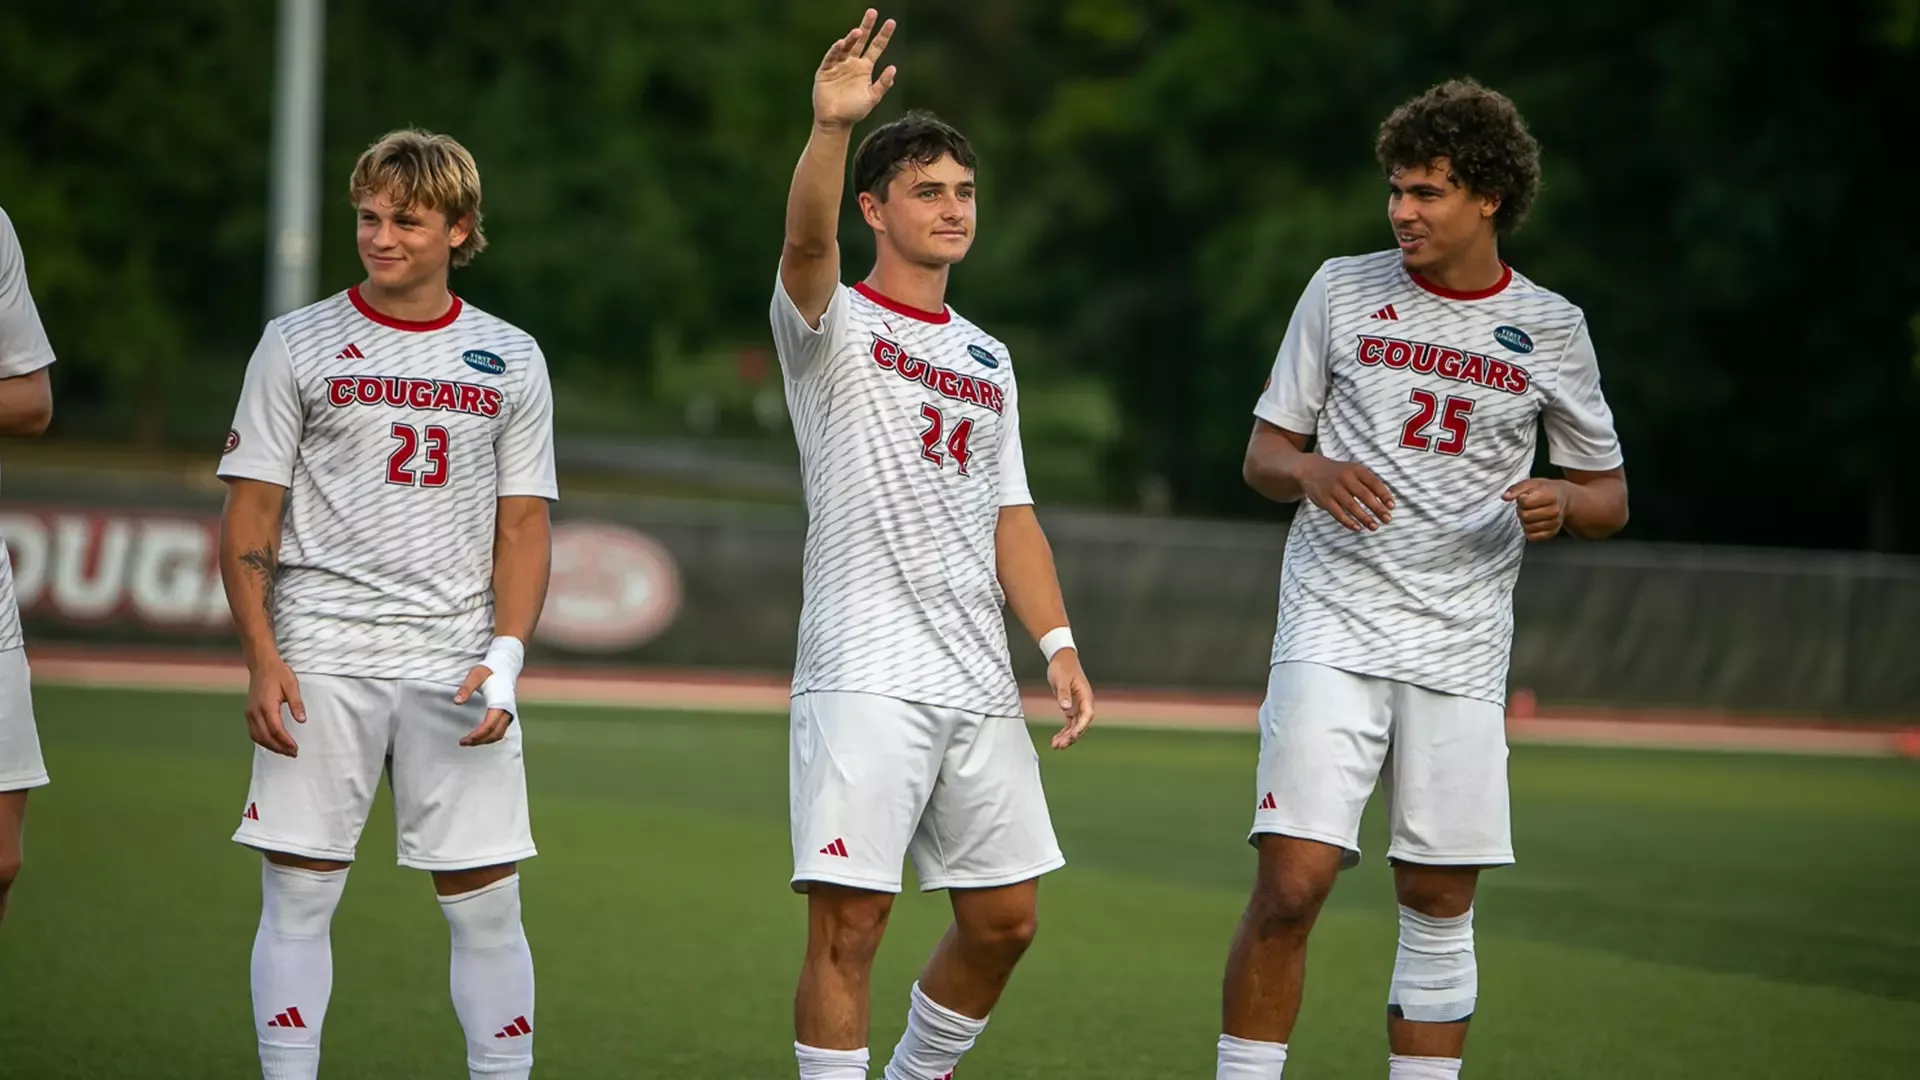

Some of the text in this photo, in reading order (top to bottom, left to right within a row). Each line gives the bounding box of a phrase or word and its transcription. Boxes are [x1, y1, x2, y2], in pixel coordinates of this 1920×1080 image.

[324, 375, 504, 419] COUGARS
[1356, 334, 1532, 395] COUGARS
[385, 421, 450, 488] 23
[919, 401, 975, 478] 24
[1398, 387, 1476, 457] 25
